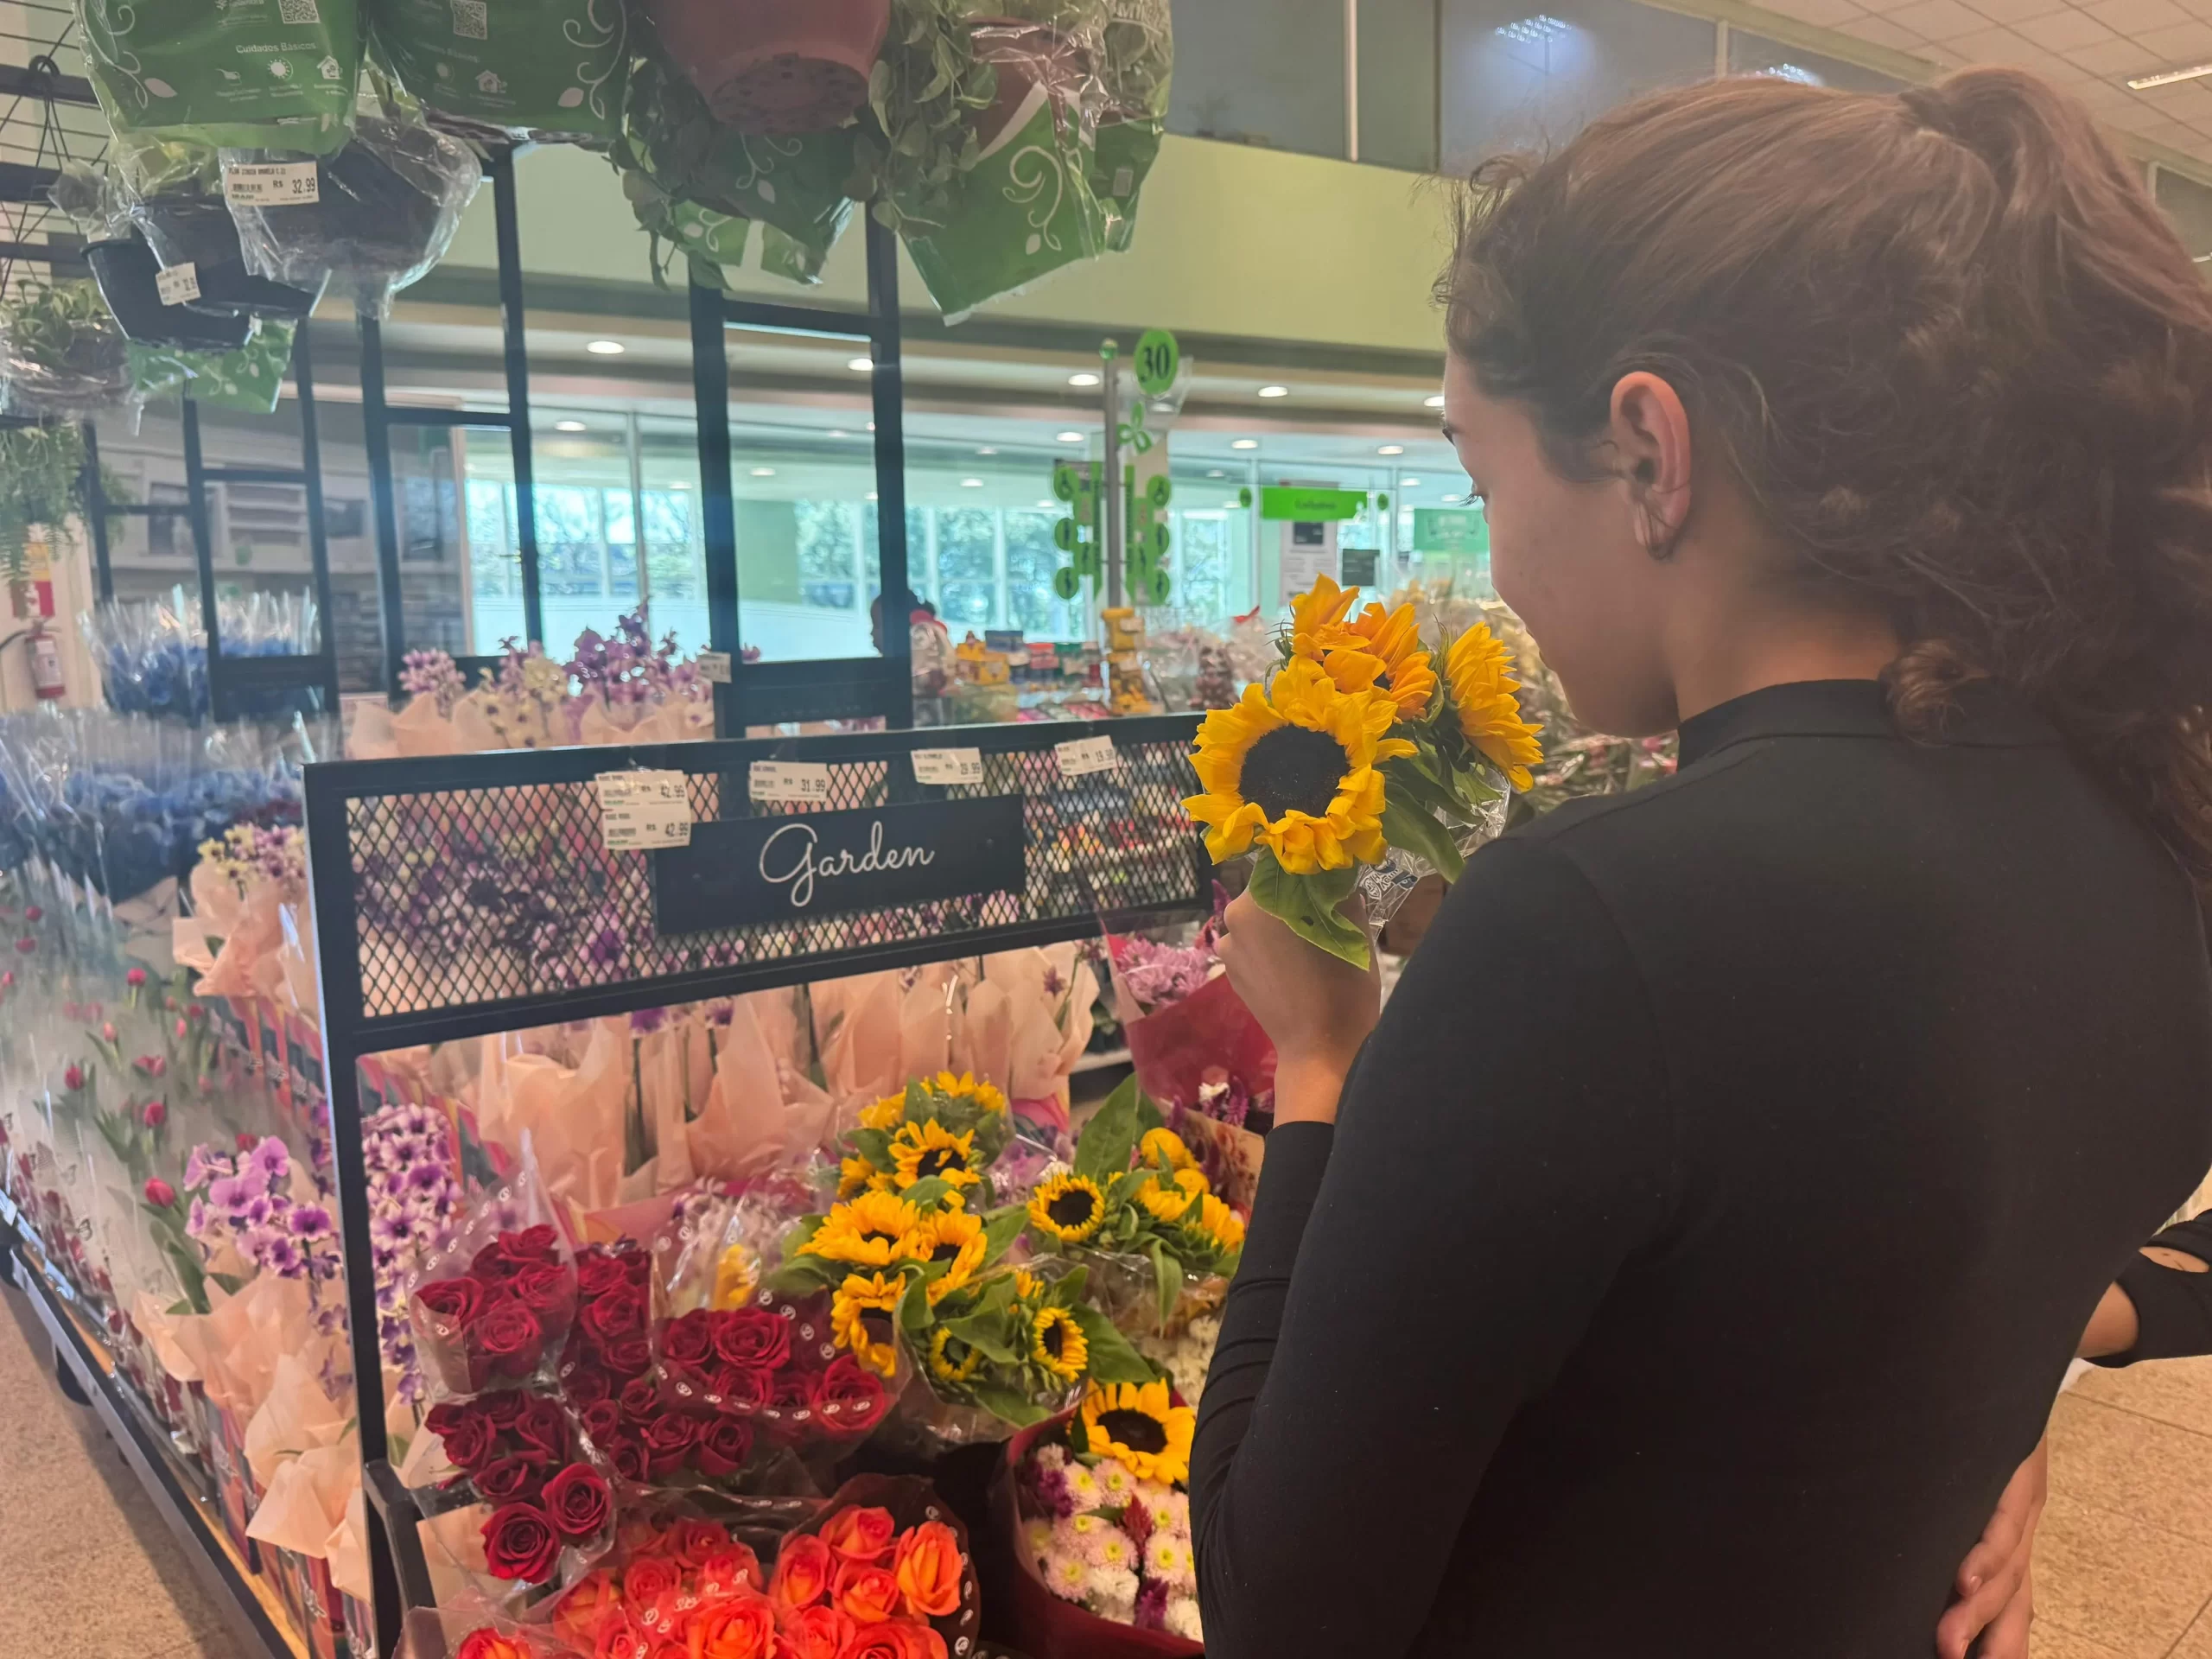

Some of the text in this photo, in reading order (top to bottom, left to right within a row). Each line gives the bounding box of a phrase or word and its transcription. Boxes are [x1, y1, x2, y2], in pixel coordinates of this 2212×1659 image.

[235, 44, 279, 54] Cuidados
[292, 177, 315, 194] 32.99
[1140, 341, 1171, 384] 30
[801, 779, 826, 792] 31.99
[664, 822, 689, 837] 42.99
[760, 820, 936, 907] Garden
